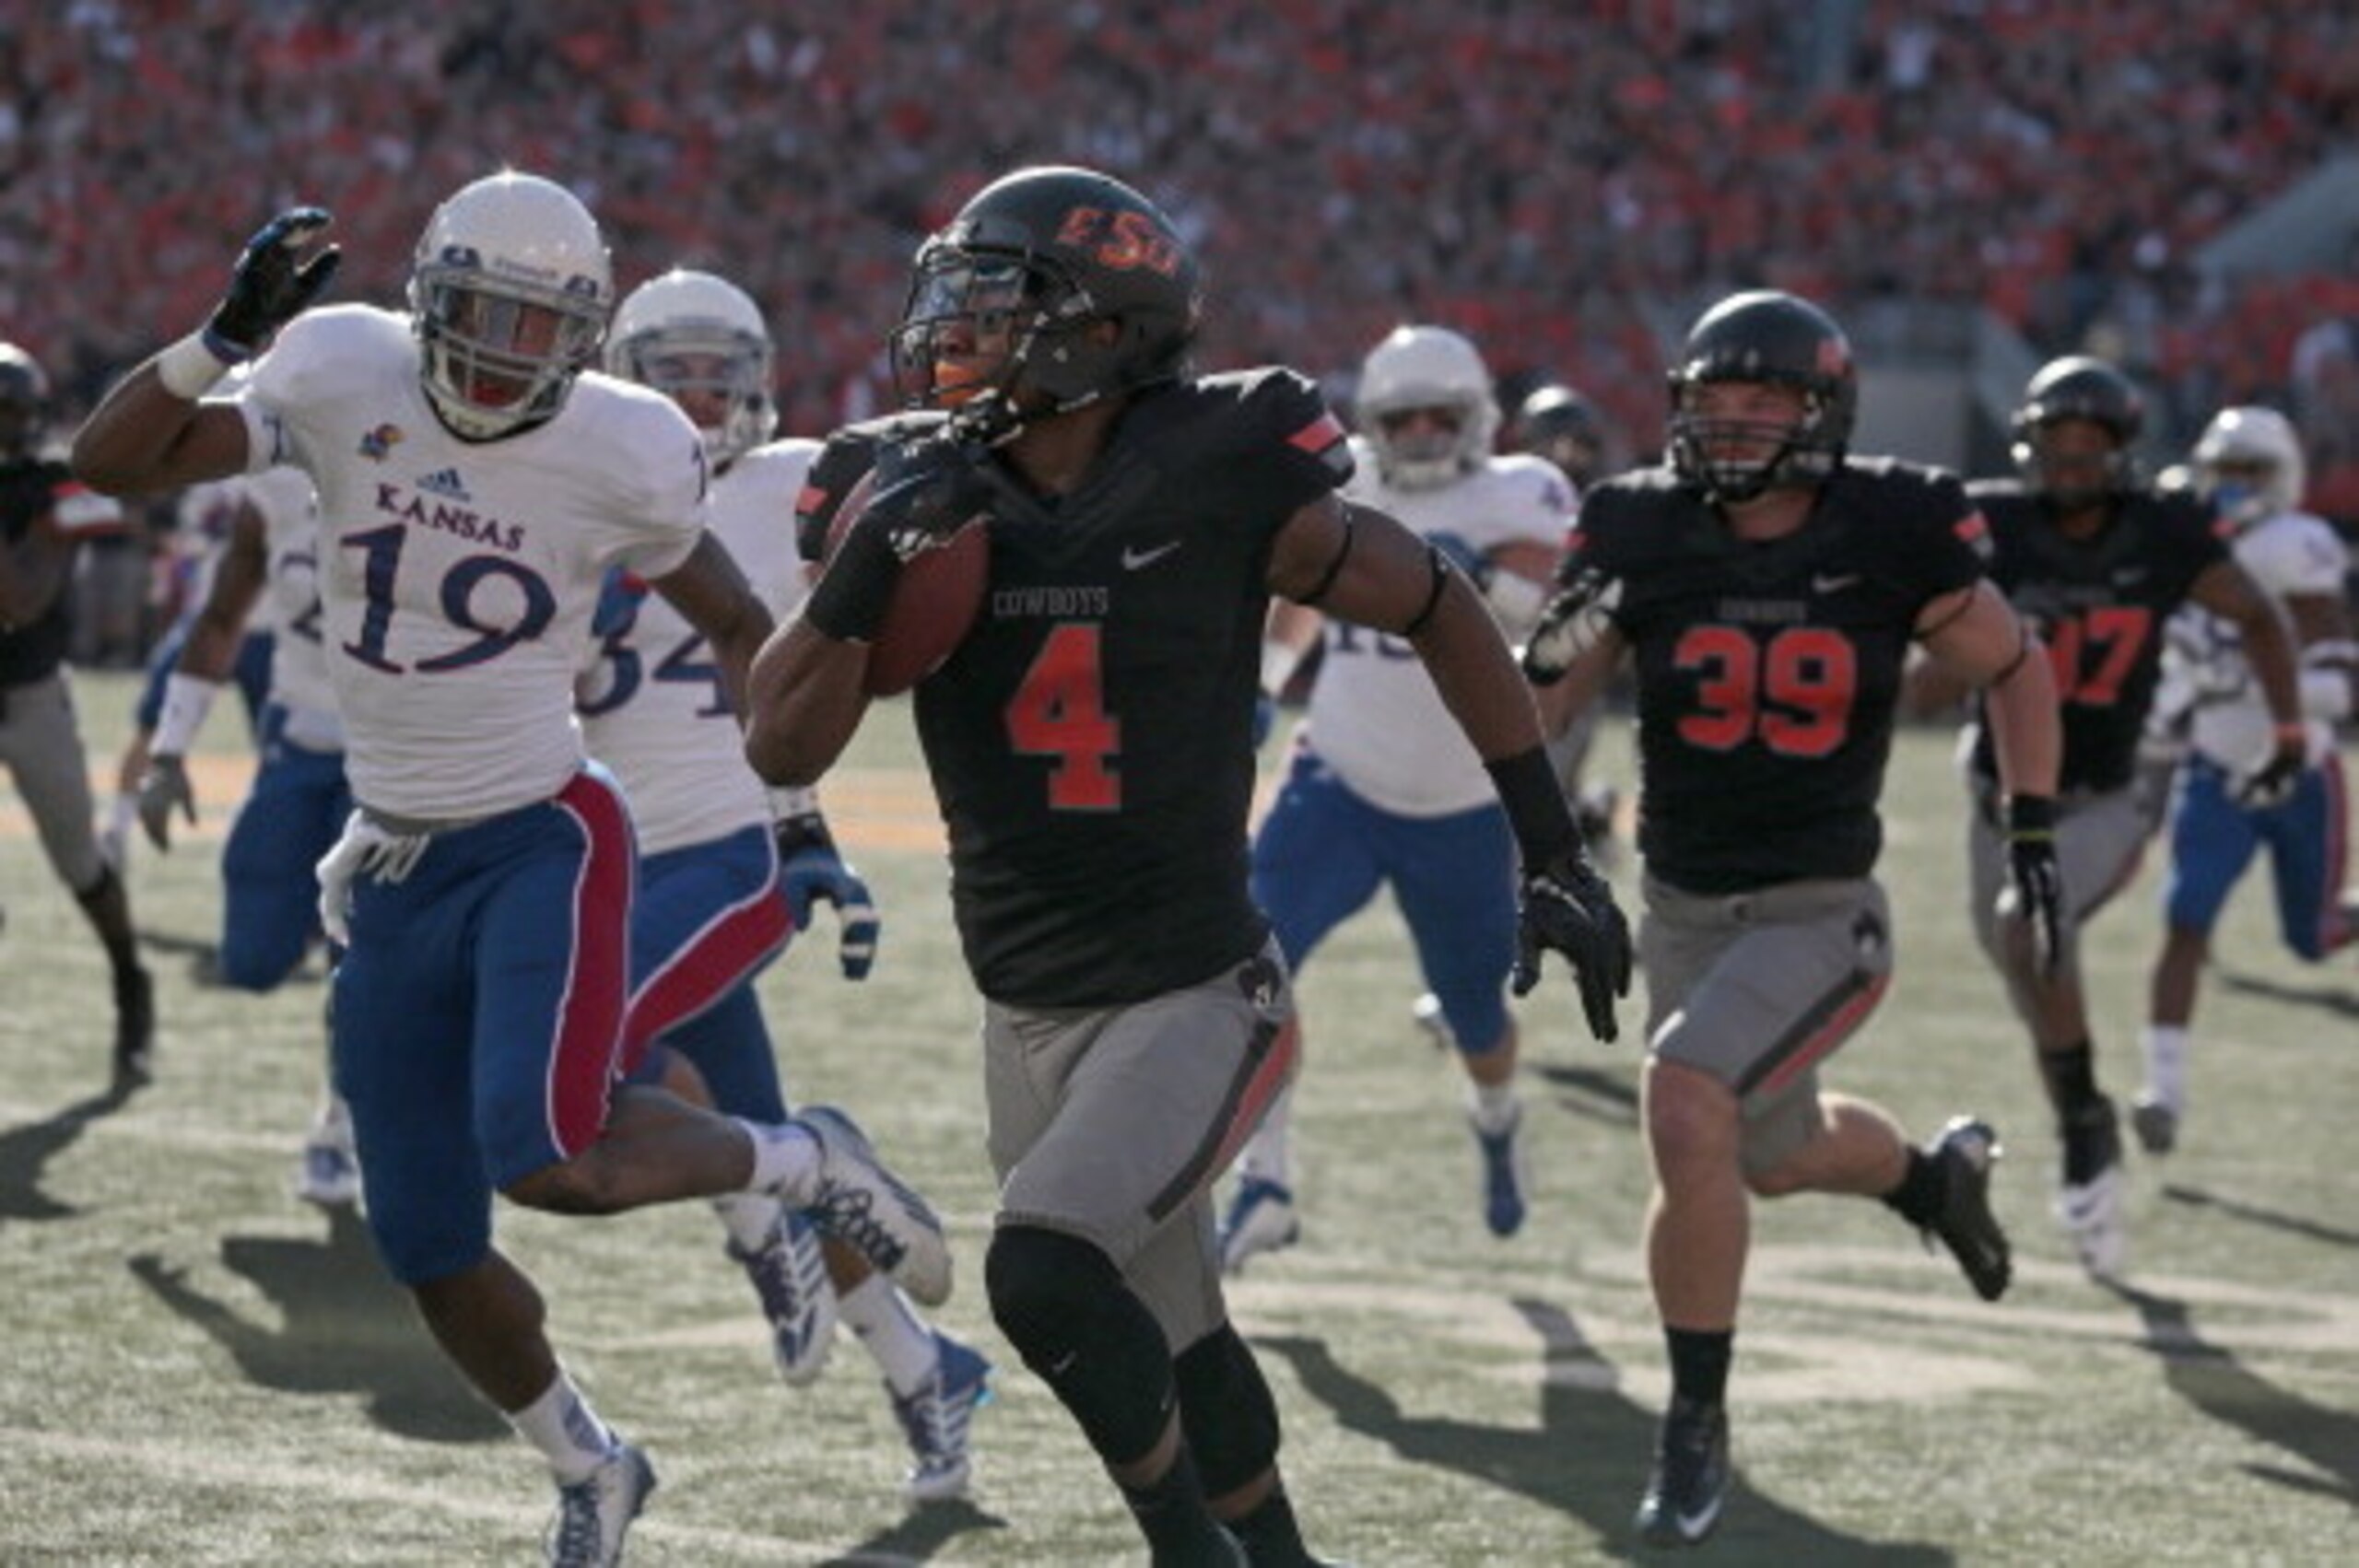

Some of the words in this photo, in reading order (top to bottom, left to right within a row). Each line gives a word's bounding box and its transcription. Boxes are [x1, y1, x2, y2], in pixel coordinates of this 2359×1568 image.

[376, 482, 525, 553] KANSAS
[339, 523, 557, 675] 19
[992, 586, 1110, 616] COWBOYS
[1004, 621, 1121, 812] 4
[1672, 625, 1858, 757] 39
